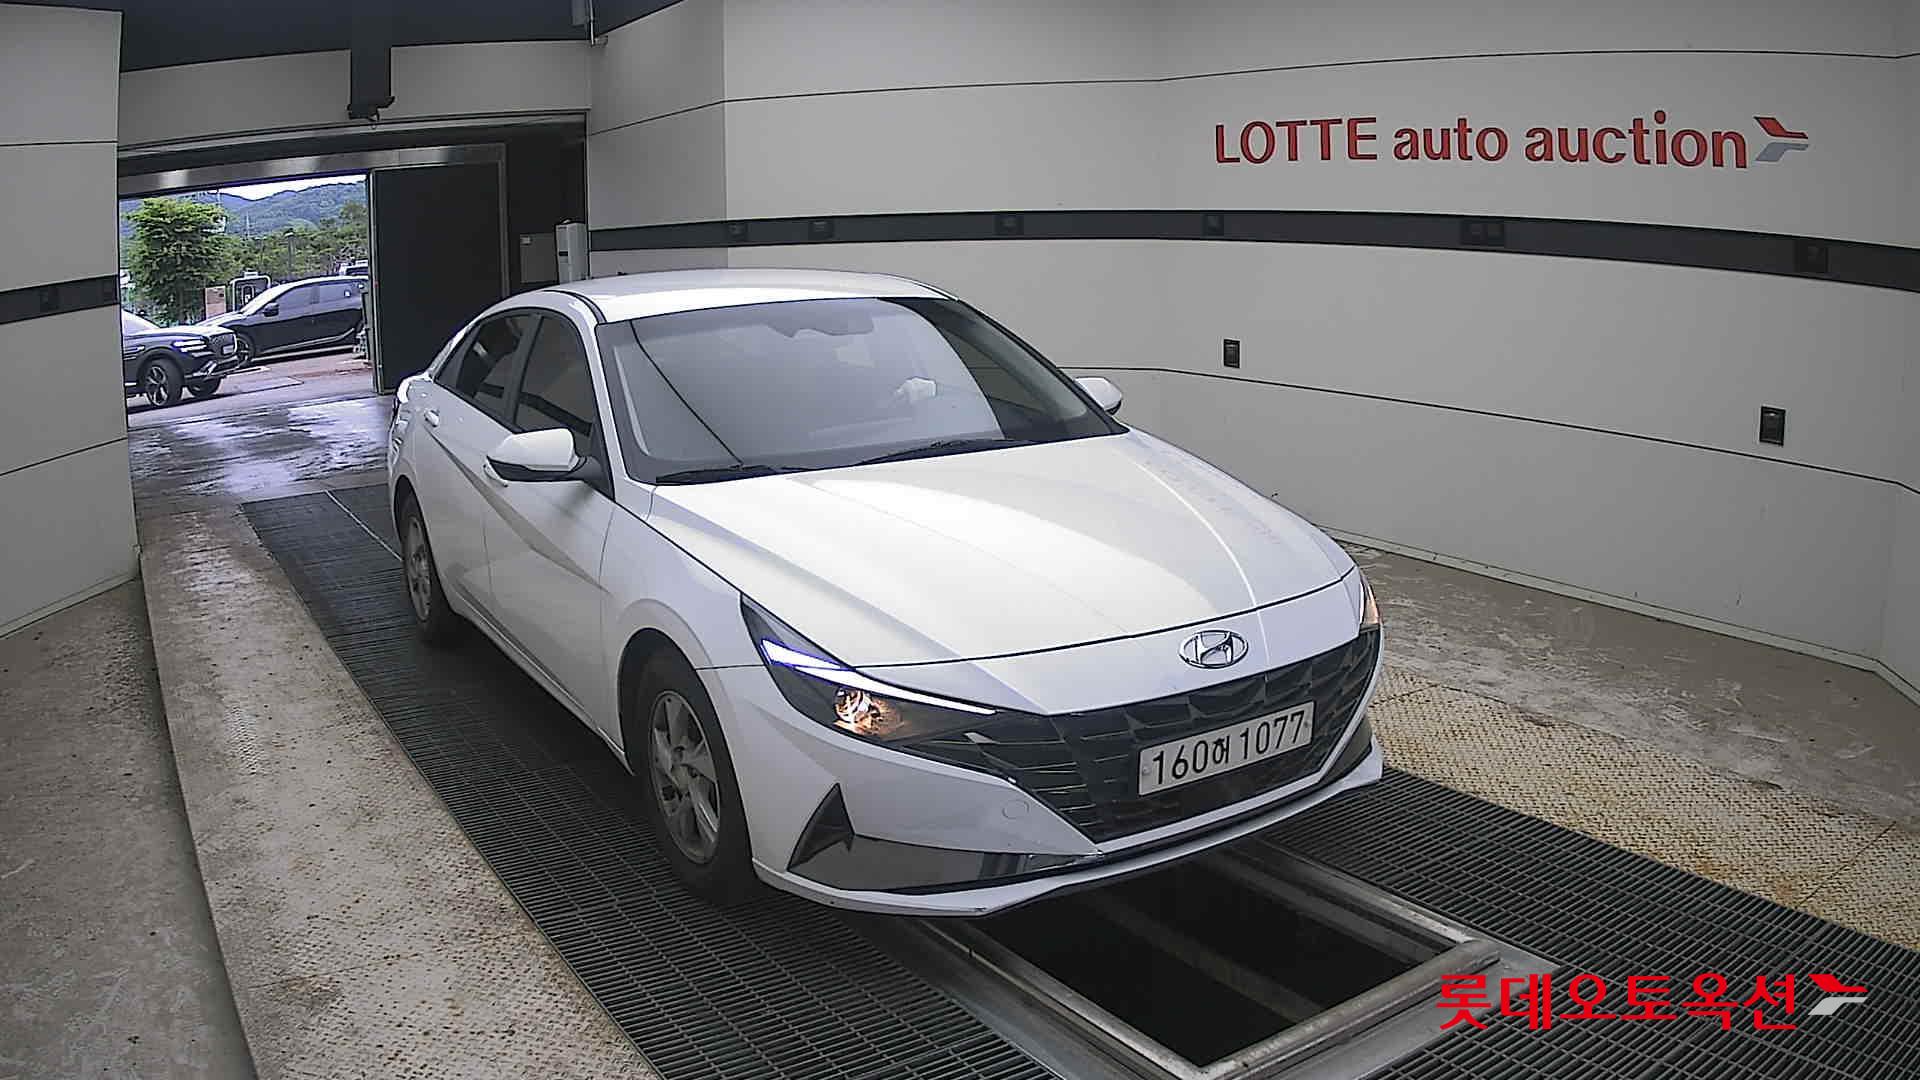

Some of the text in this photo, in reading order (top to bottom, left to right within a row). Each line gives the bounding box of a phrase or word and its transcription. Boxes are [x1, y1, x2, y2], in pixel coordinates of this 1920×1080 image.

[1215, 110, 1748, 168] LOTTE auto auction
[1152, 710, 1305, 785] 160허 1077
